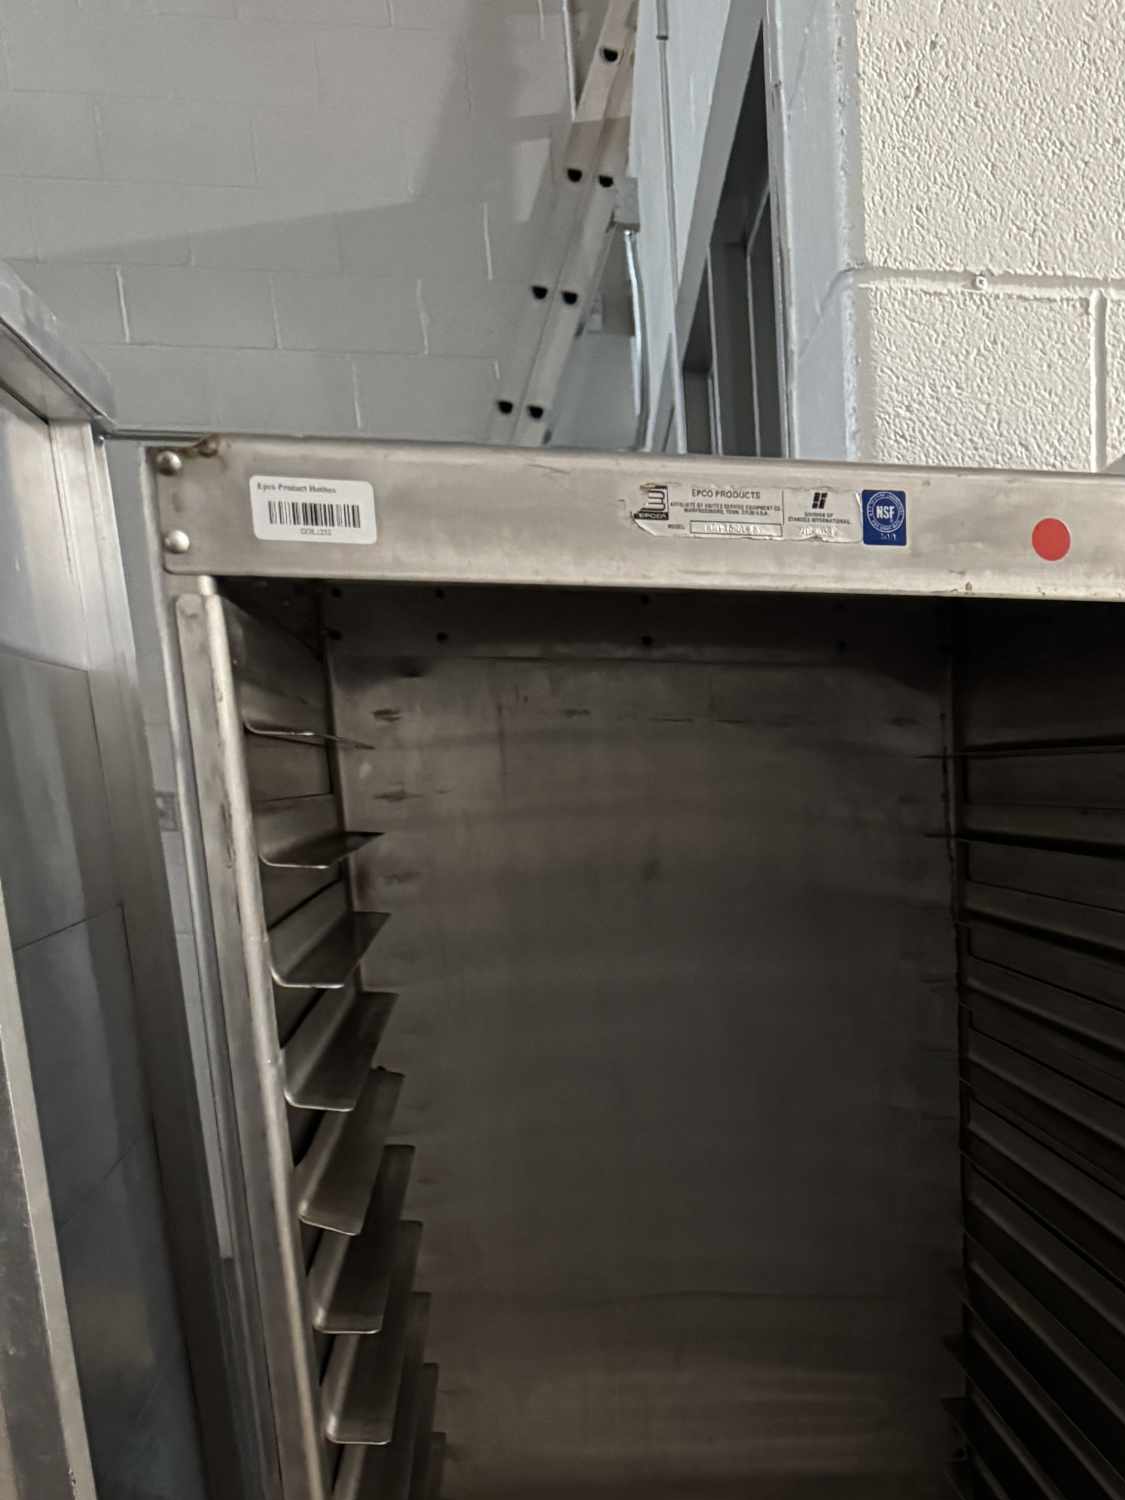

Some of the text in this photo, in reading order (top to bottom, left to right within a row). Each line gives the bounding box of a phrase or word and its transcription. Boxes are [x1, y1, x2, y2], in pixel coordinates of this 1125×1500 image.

[691, 488, 761, 500] EPCO PRODUCTS
[875, 504, 896, 520] NSF
